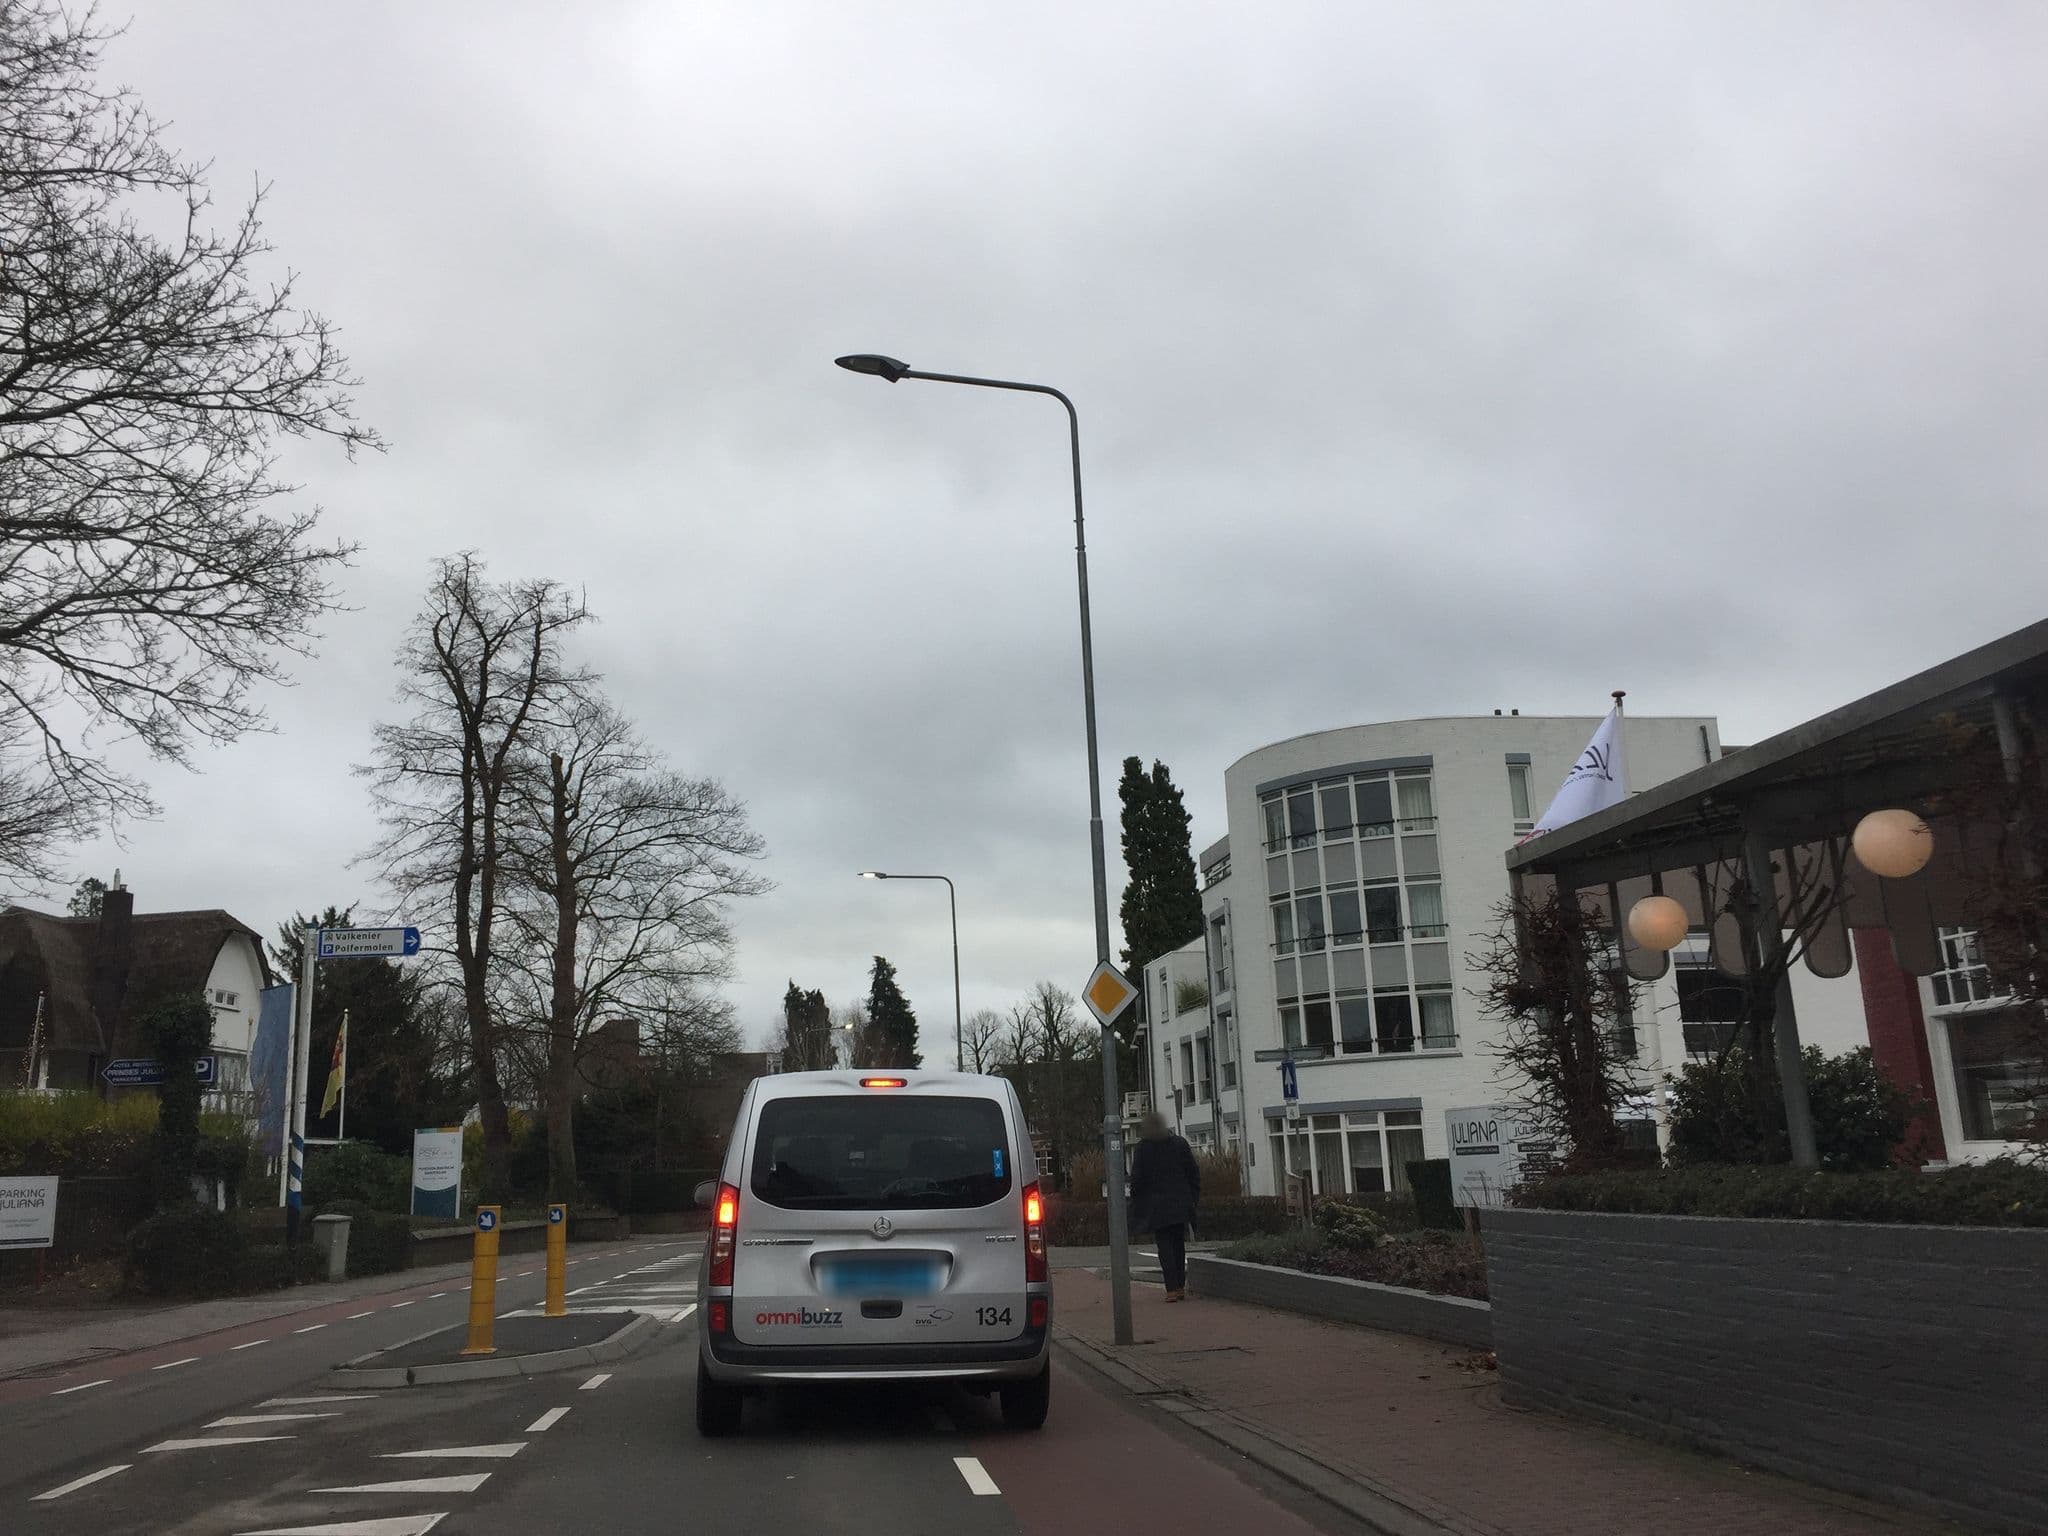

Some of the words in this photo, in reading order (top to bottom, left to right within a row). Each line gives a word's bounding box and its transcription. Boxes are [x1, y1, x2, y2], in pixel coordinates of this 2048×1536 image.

[336, 932, 381, 941] Valkenier
[335, 944, 393, 952] Polfermolen
[195, 1060, 209, 1073] P
[1452, 1120, 1499, 1151] JULIANA
[0, 1188, 46, 1198] PARKING
[756, 1306, 843, 1325] omnibuzz
[975, 1306, 1012, 1326] 134
